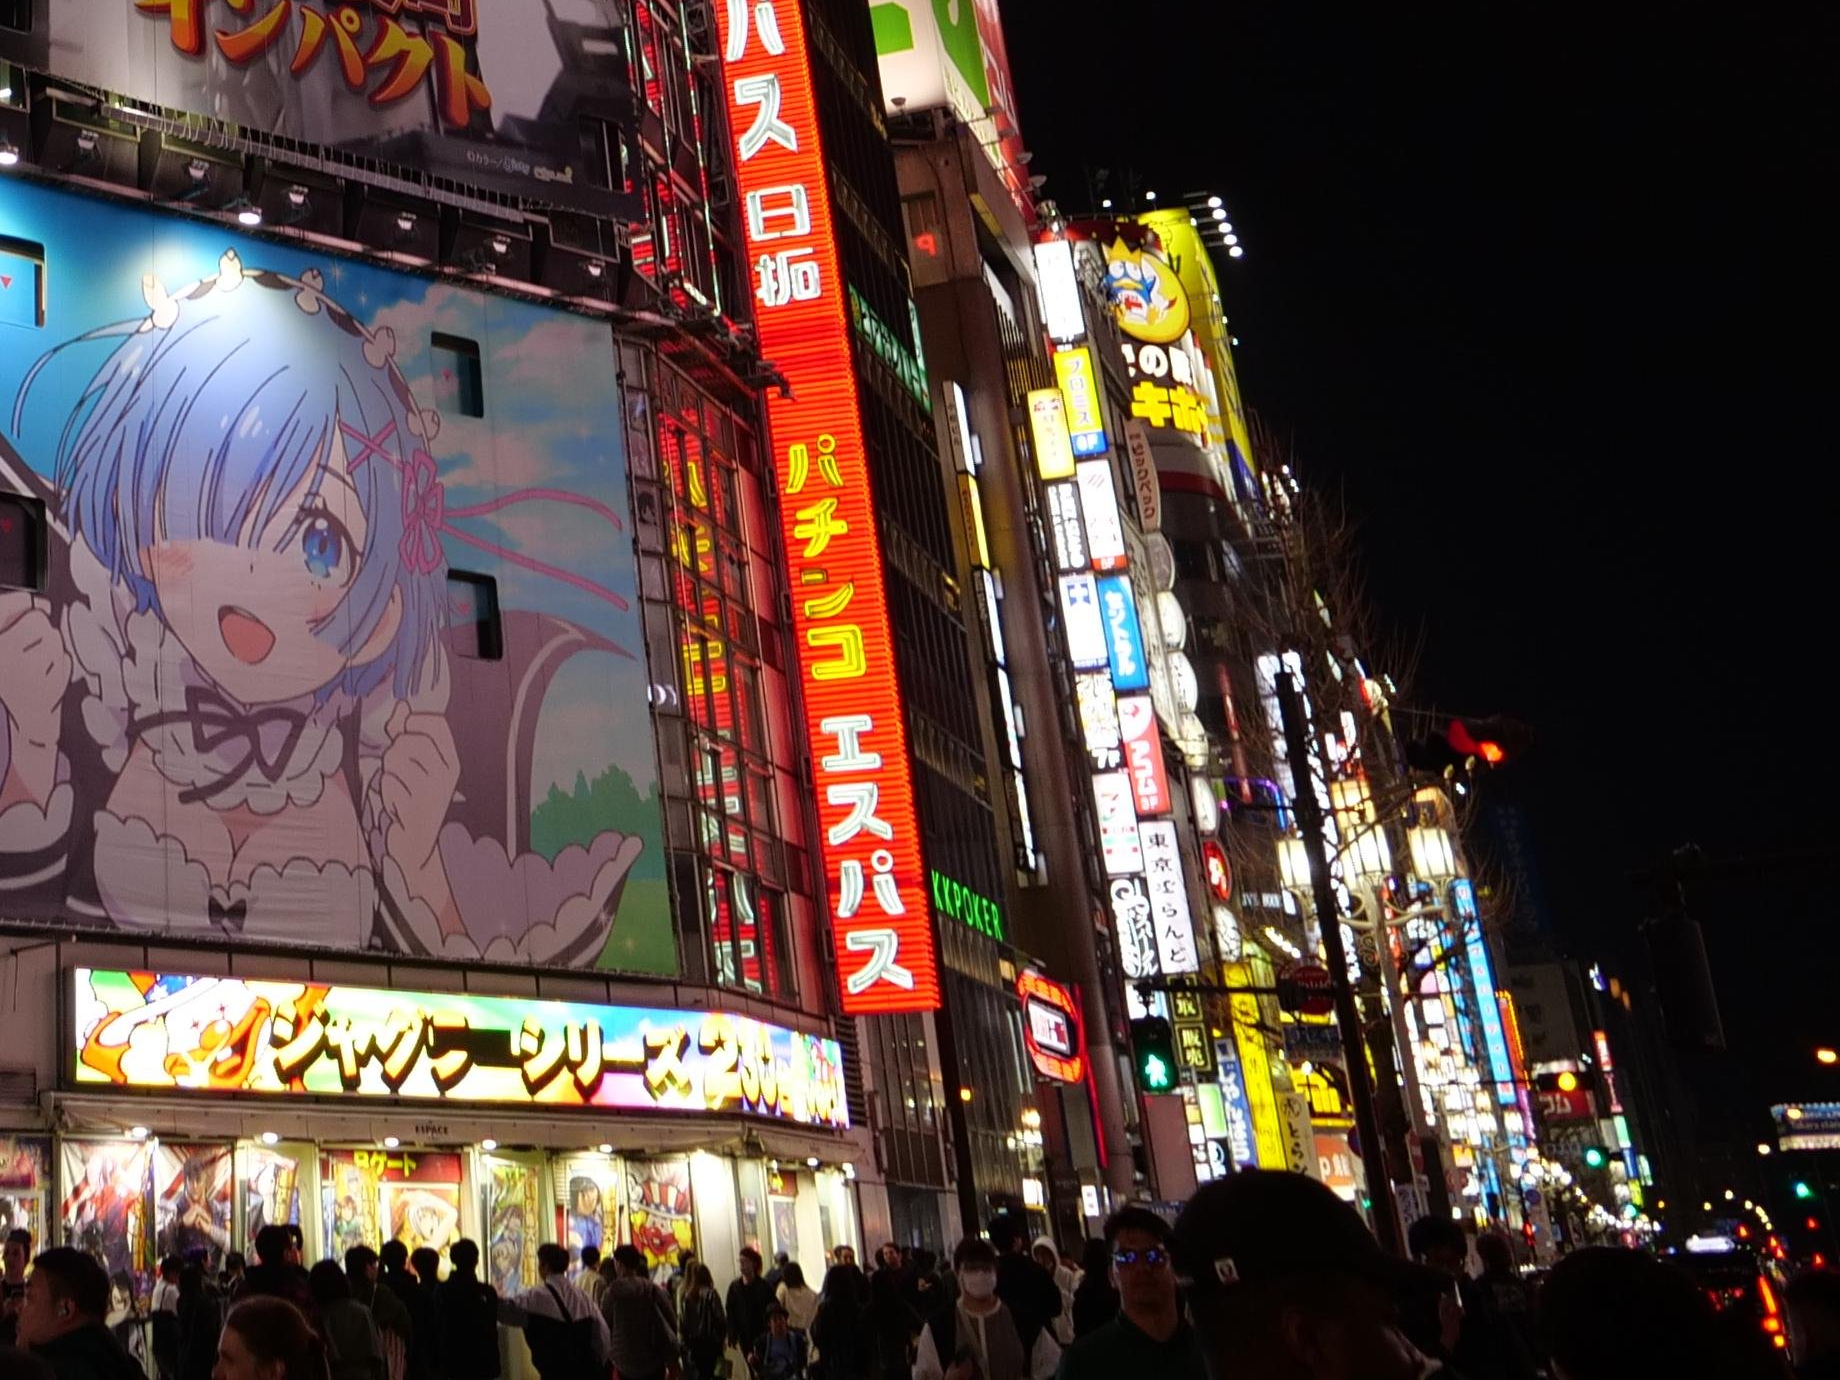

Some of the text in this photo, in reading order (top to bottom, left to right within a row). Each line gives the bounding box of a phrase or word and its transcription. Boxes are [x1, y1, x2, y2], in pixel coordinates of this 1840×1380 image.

[745, 185, 822, 308] 日拓
[1065, 358, 1092, 425] プロミス
[786, 434, 867, 681] パチンコ
[818, 714, 915, 996] エスパス
[931, 869, 1003, 942] KKPOKER
[272, 1000, 691, 1095] ジャグラーシリーズ
[415, 1124, 449, 1136] ESPACE
